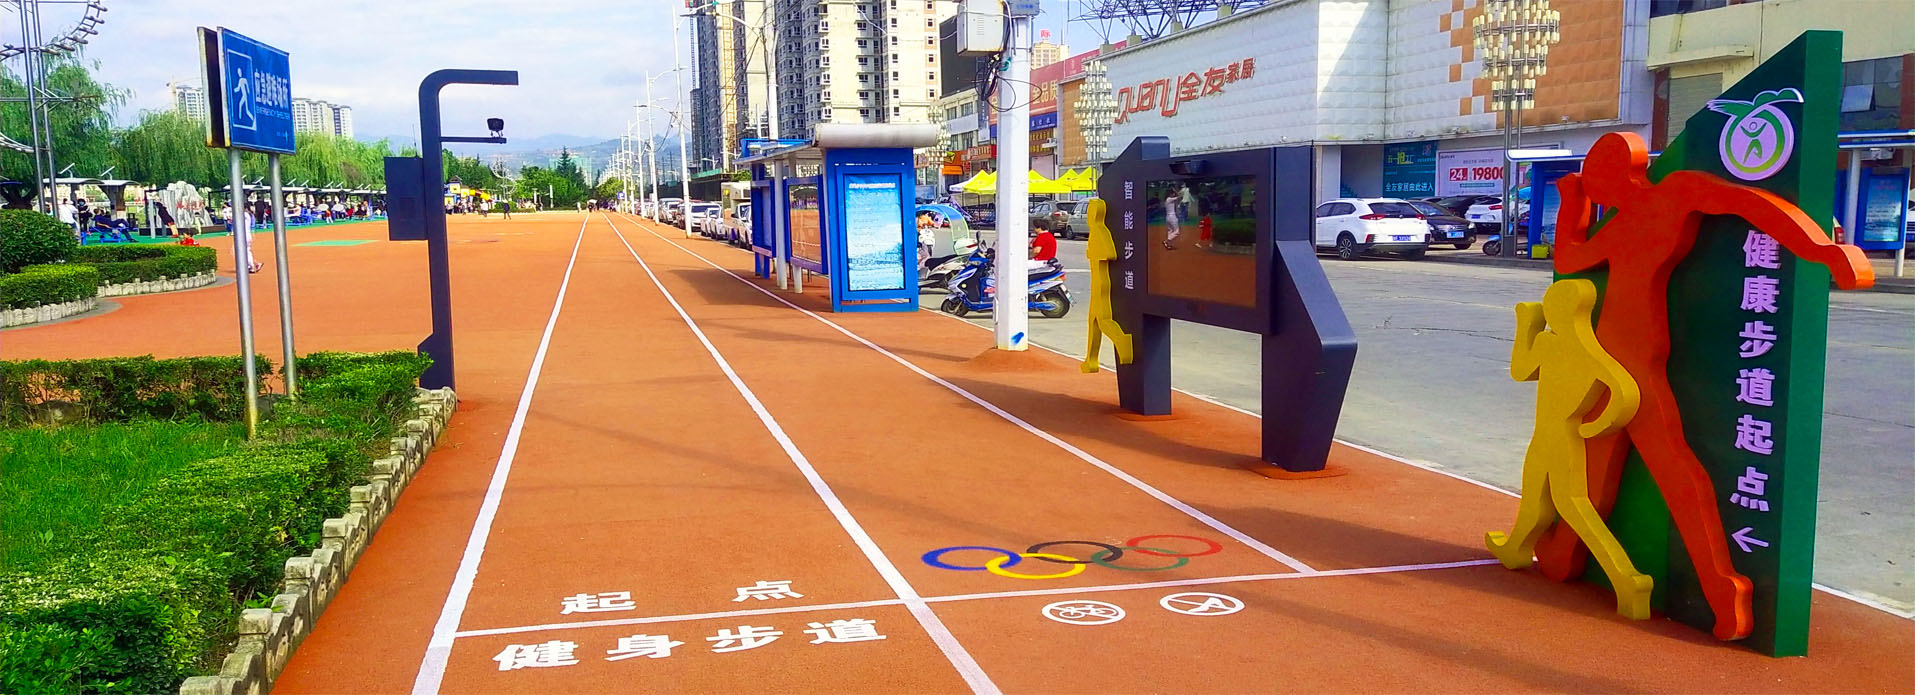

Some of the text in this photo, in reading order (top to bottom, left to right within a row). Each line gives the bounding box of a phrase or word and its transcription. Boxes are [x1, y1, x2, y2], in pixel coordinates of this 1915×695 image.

[1123, 180, 1135, 291] 智能步道
[1730, 229, 1782, 513] 健康步道起点
[560, 580, 804, 615] 起点
[492, 618, 887, 671] 健身步道
